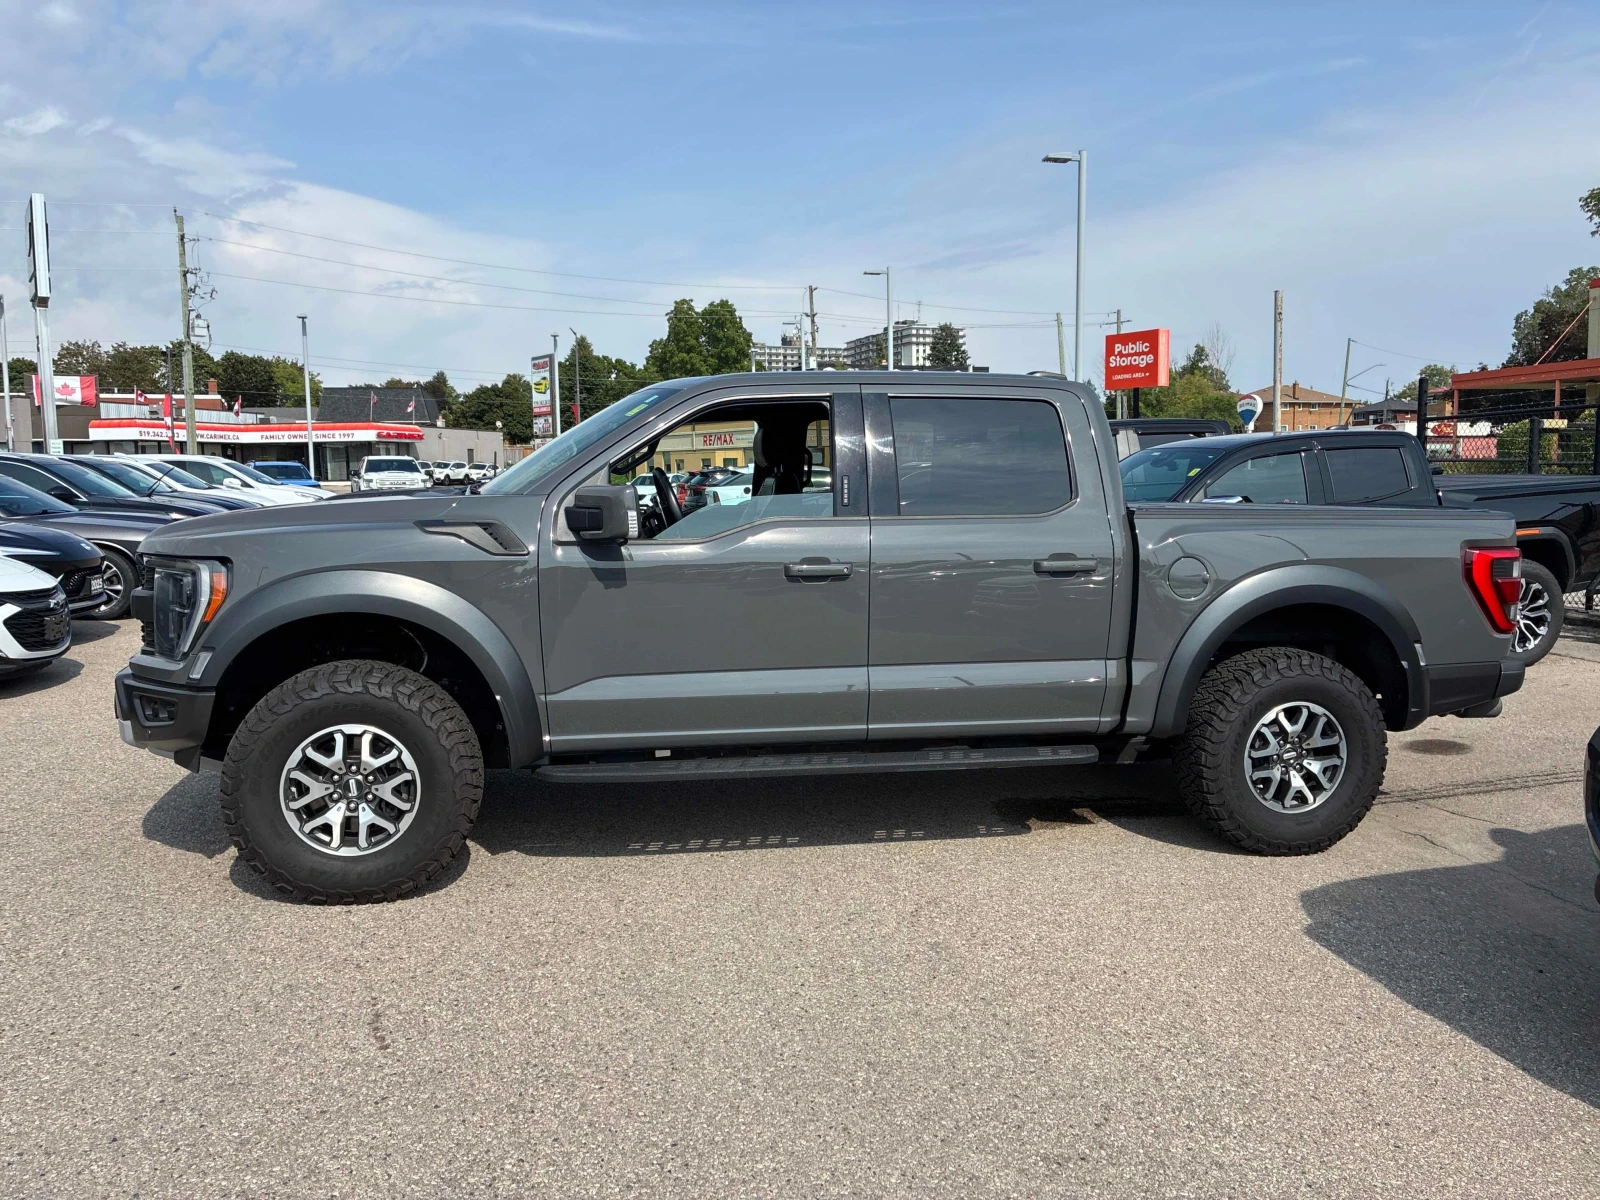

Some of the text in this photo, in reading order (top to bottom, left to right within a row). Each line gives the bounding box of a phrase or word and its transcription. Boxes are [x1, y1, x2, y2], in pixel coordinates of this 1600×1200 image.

[1114, 341, 1150, 355] Public
[1109, 354, 1154, 367] Storage
[703, 432, 734, 447] RE/MAX
